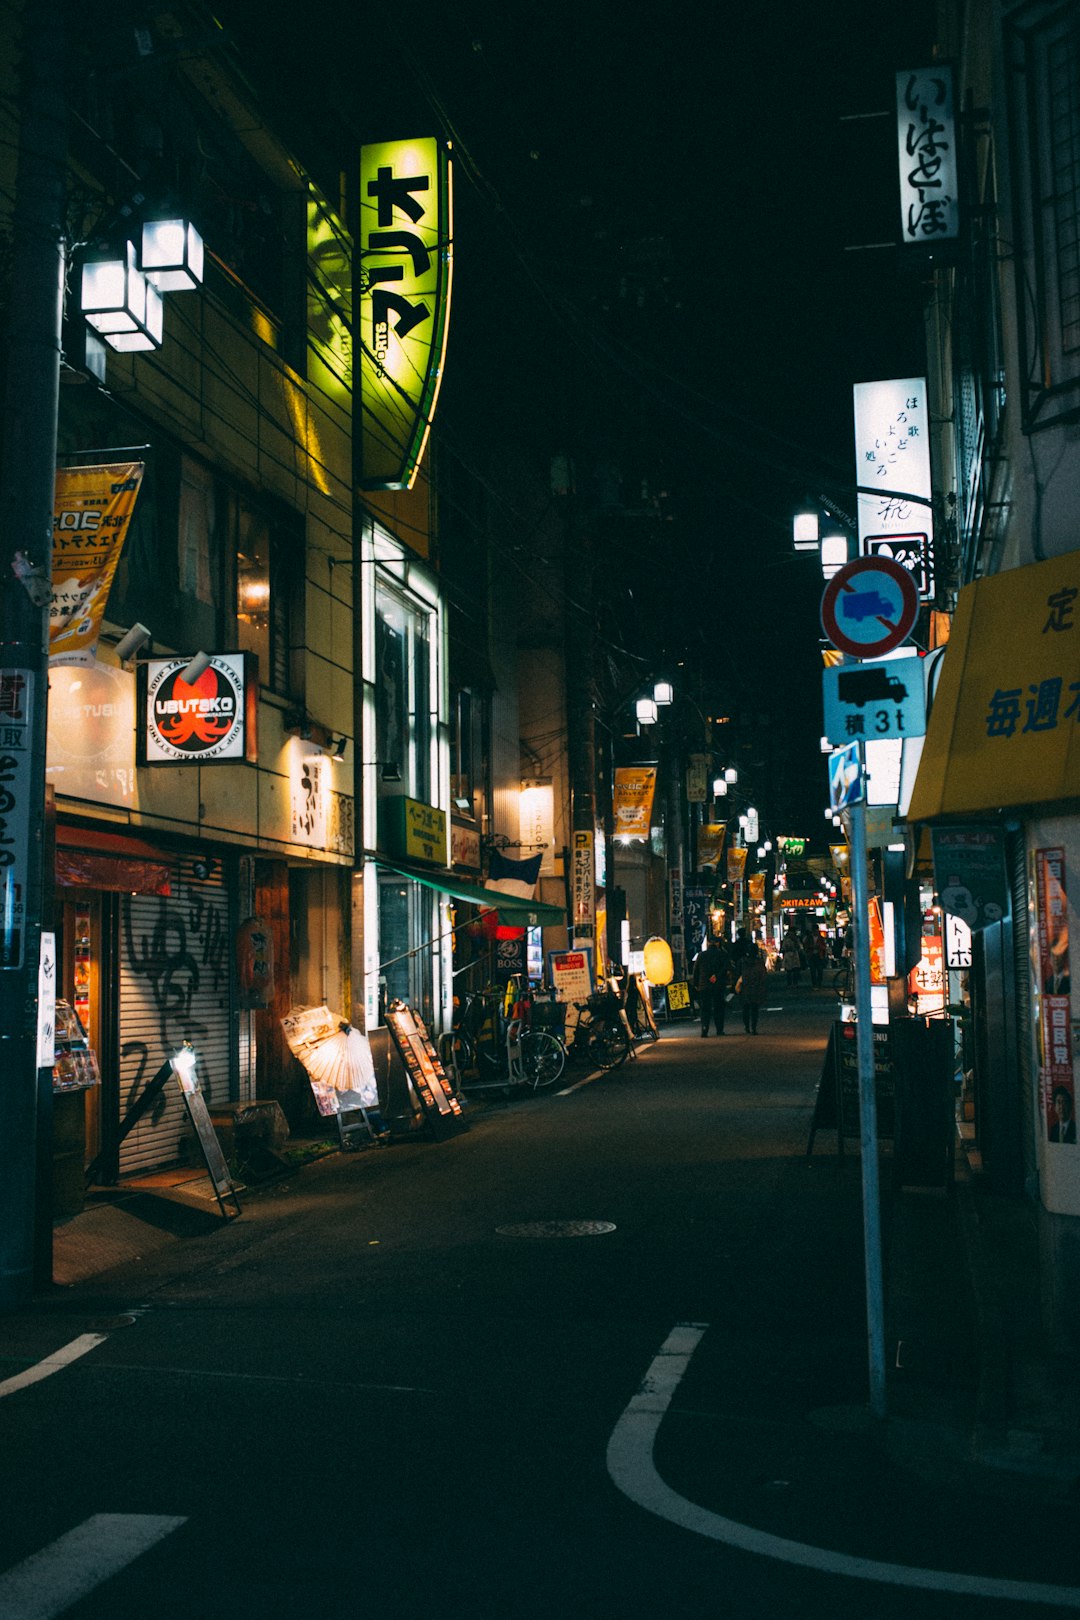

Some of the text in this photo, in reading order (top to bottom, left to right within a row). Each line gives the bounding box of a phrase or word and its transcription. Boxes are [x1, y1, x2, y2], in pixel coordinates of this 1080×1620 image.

[367, 166, 431, 350] マリオ
[819, 494, 857, 529] SHIMOKITAZ
[1042, 586, 1079, 634] 定
[575, 834, 587, 849] P
[497, 959, 523, 968] BOSS
[872, 1032, 889, 1042] ENU
[1052, 1009, 1069, 1065] 自民党
